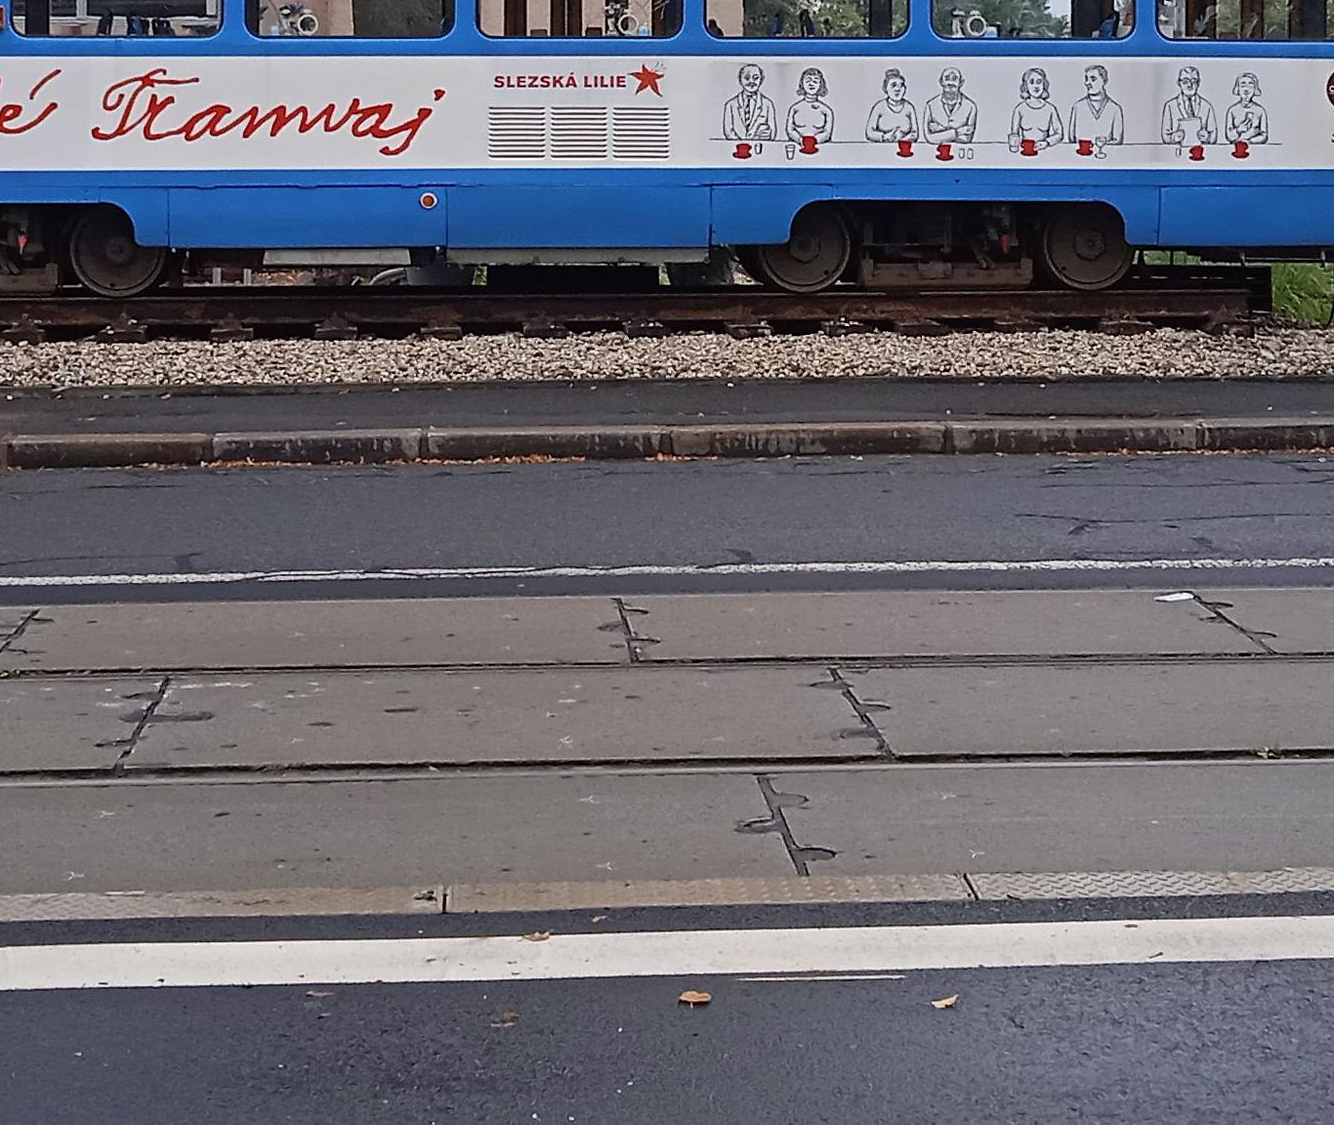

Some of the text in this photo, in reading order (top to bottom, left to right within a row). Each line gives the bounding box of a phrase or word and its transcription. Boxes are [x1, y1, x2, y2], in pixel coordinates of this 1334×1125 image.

[493, 72, 627, 88] SLEZSKÁ LILIE
[91, 67, 446, 156] Tramvaj
